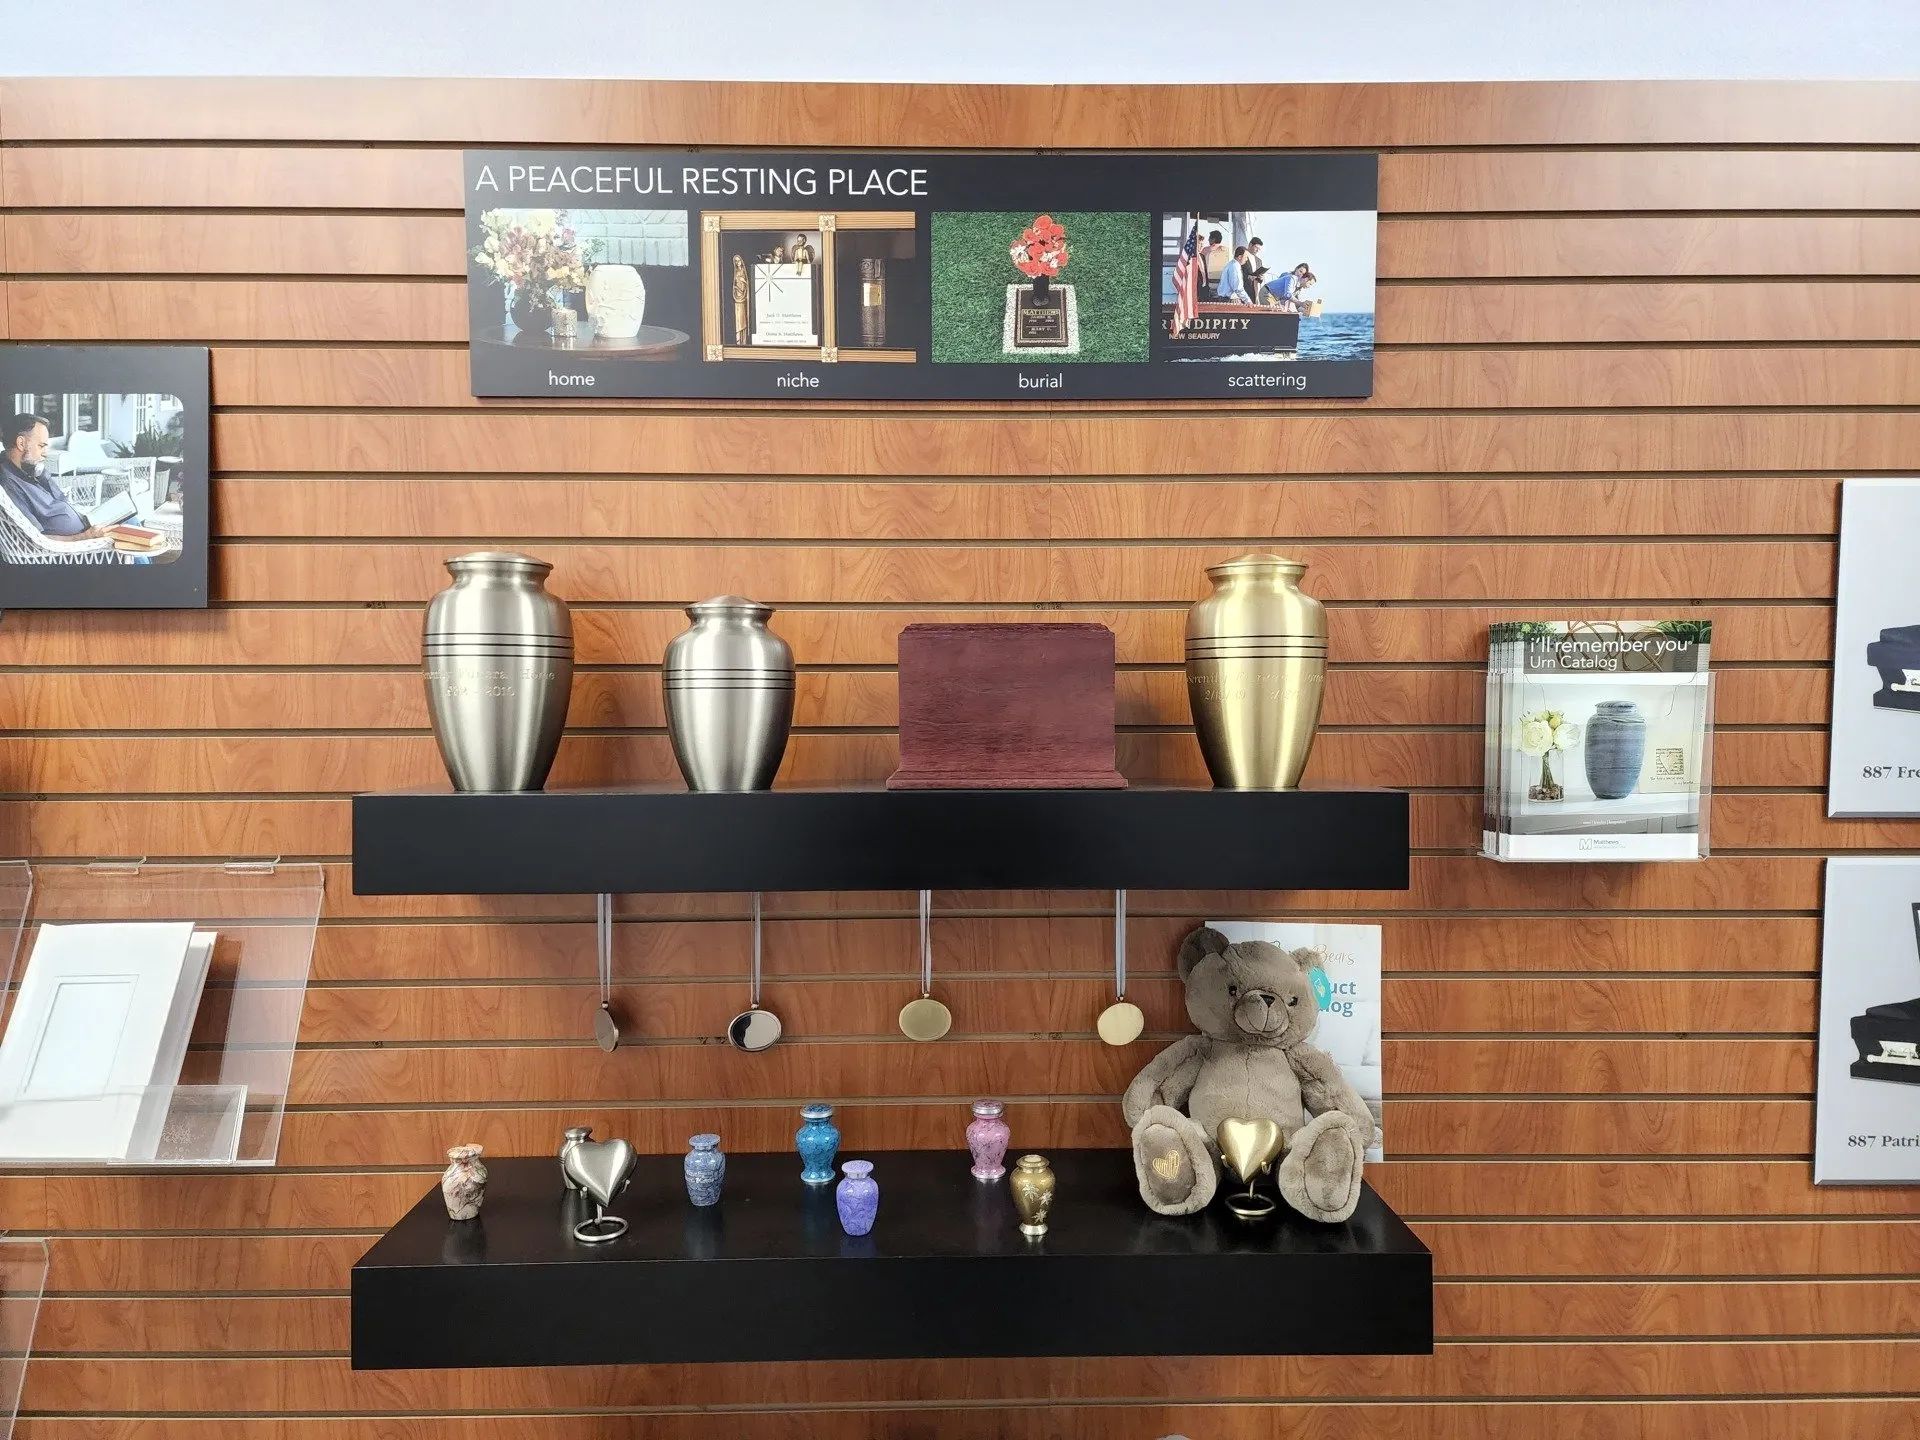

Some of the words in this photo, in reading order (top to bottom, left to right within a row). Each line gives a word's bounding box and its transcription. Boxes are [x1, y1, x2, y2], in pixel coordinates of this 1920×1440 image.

[474, 164, 499, 192] A
[508, 165, 673, 194] PEACEFUL
[682, 167, 817, 196] RESTING
[828, 168, 928, 196] PLACE
[1187, 332, 1221, 340] SEABURY
[548, 370, 596, 387] home
[776, 371, 820, 388] niche
[1018, 372, 1063, 389] burial
[1227, 371, 1308, 391] scattering
[1554, 635, 1651, 653] remember
[1530, 655, 1556, 669] Urn
[1560, 654, 1618, 671] Catalog
[1862, 765, 1892, 779] 887
[1847, 1134, 1877, 1149] 887
[1880, 1134, 1920, 1148] Patri
